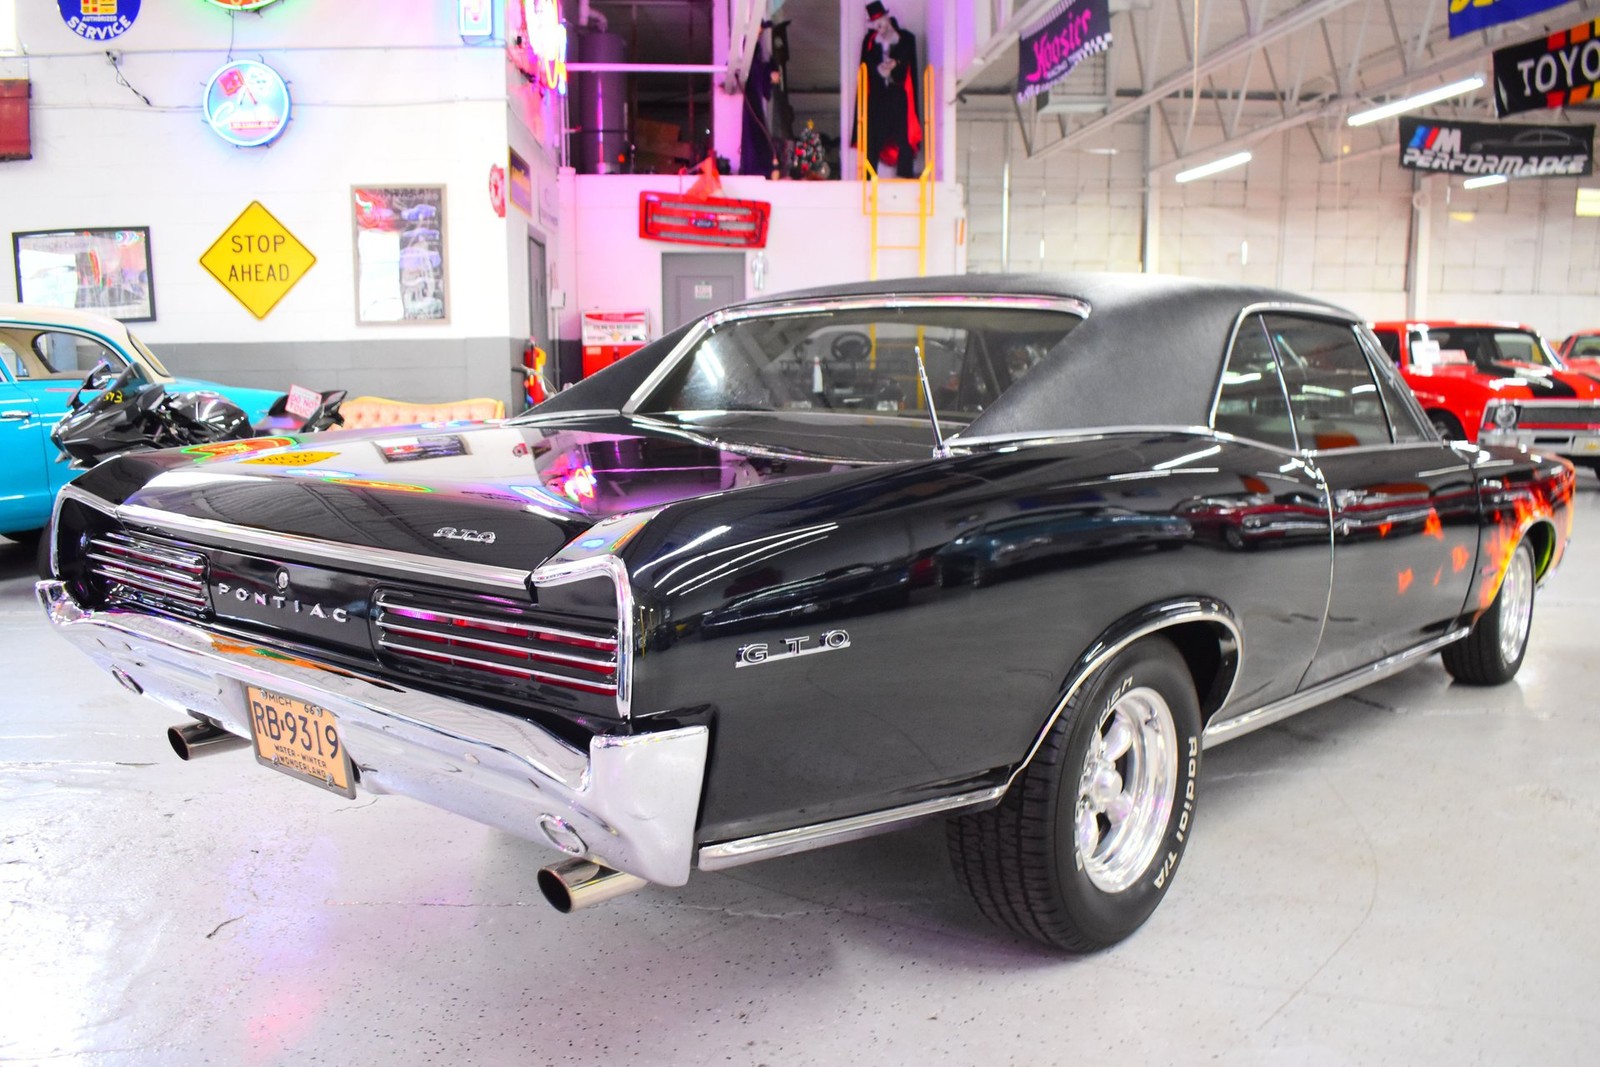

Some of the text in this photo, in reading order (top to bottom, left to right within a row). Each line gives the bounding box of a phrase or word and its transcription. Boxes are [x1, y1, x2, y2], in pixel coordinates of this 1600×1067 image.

[67, 15, 132, 40] SERVICE
[1025, 8, 1092, 82] Hoosier
[231, 234, 286, 253] STOP
[228, 263, 290, 282] AHEAD
[218, 582, 349, 623] PONTIAC
[735, 629, 851, 668] GTO
[268, 691, 316, 716] MICH 66
[1175, 736, 1198, 843] Radial
